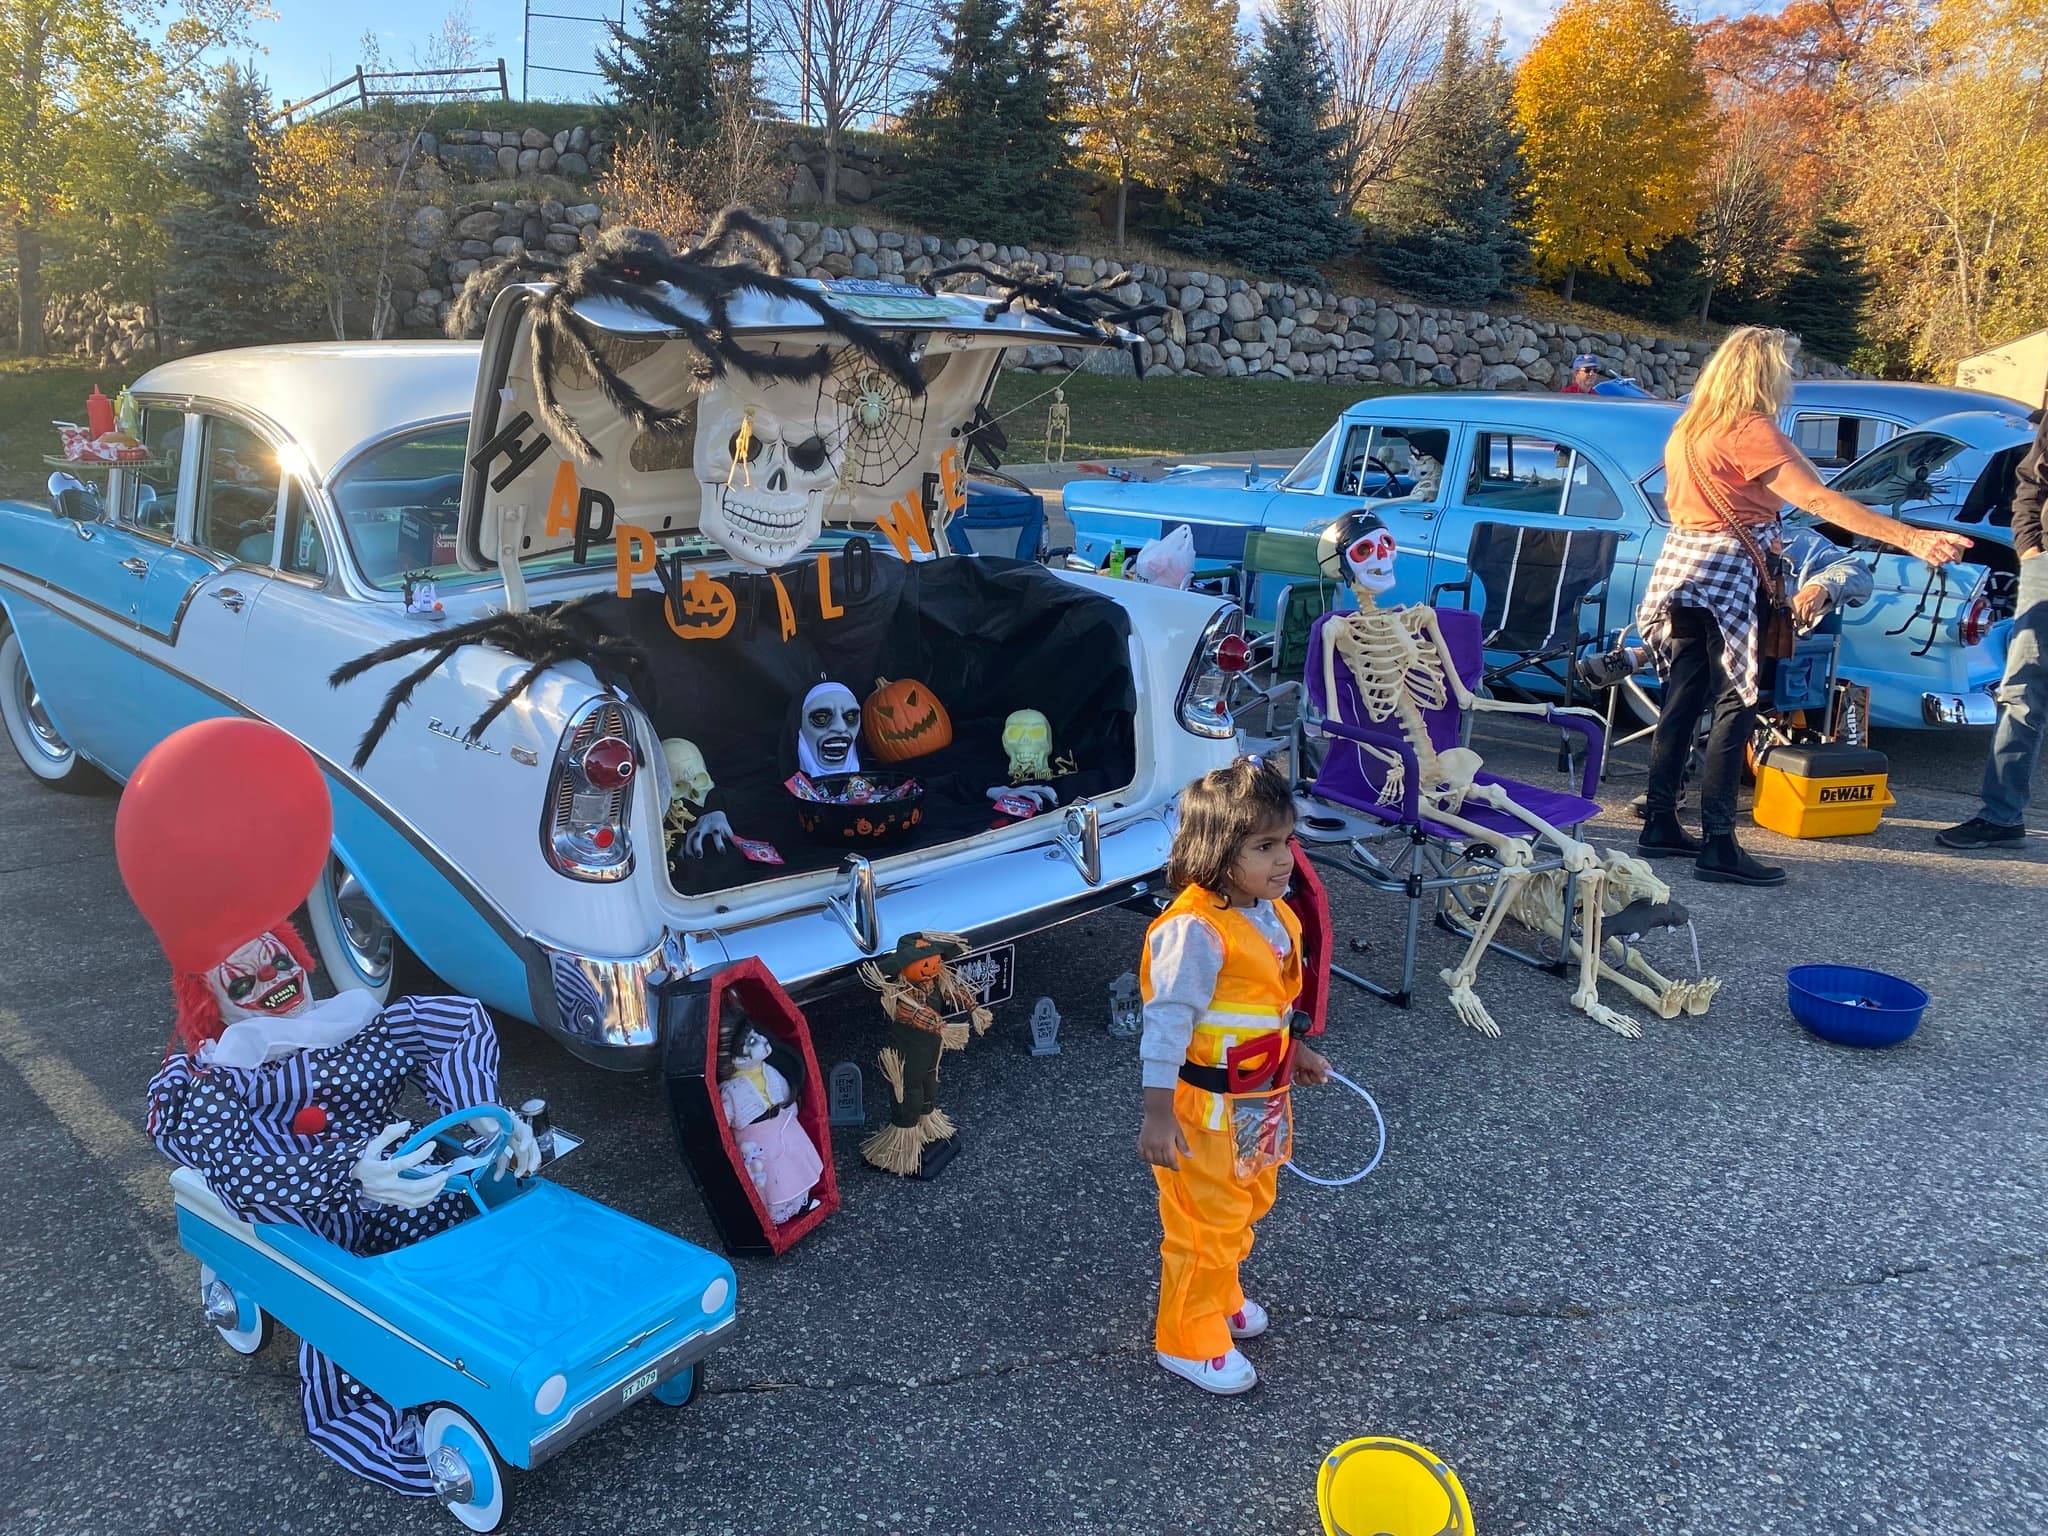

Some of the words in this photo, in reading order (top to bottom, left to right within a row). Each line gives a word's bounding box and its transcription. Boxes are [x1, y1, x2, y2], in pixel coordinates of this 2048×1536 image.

[470, 410, 688, 627] HAPPY
[1118, 1000, 1139, 1012] RIP
[636, 1371, 656, 1391] 2079
